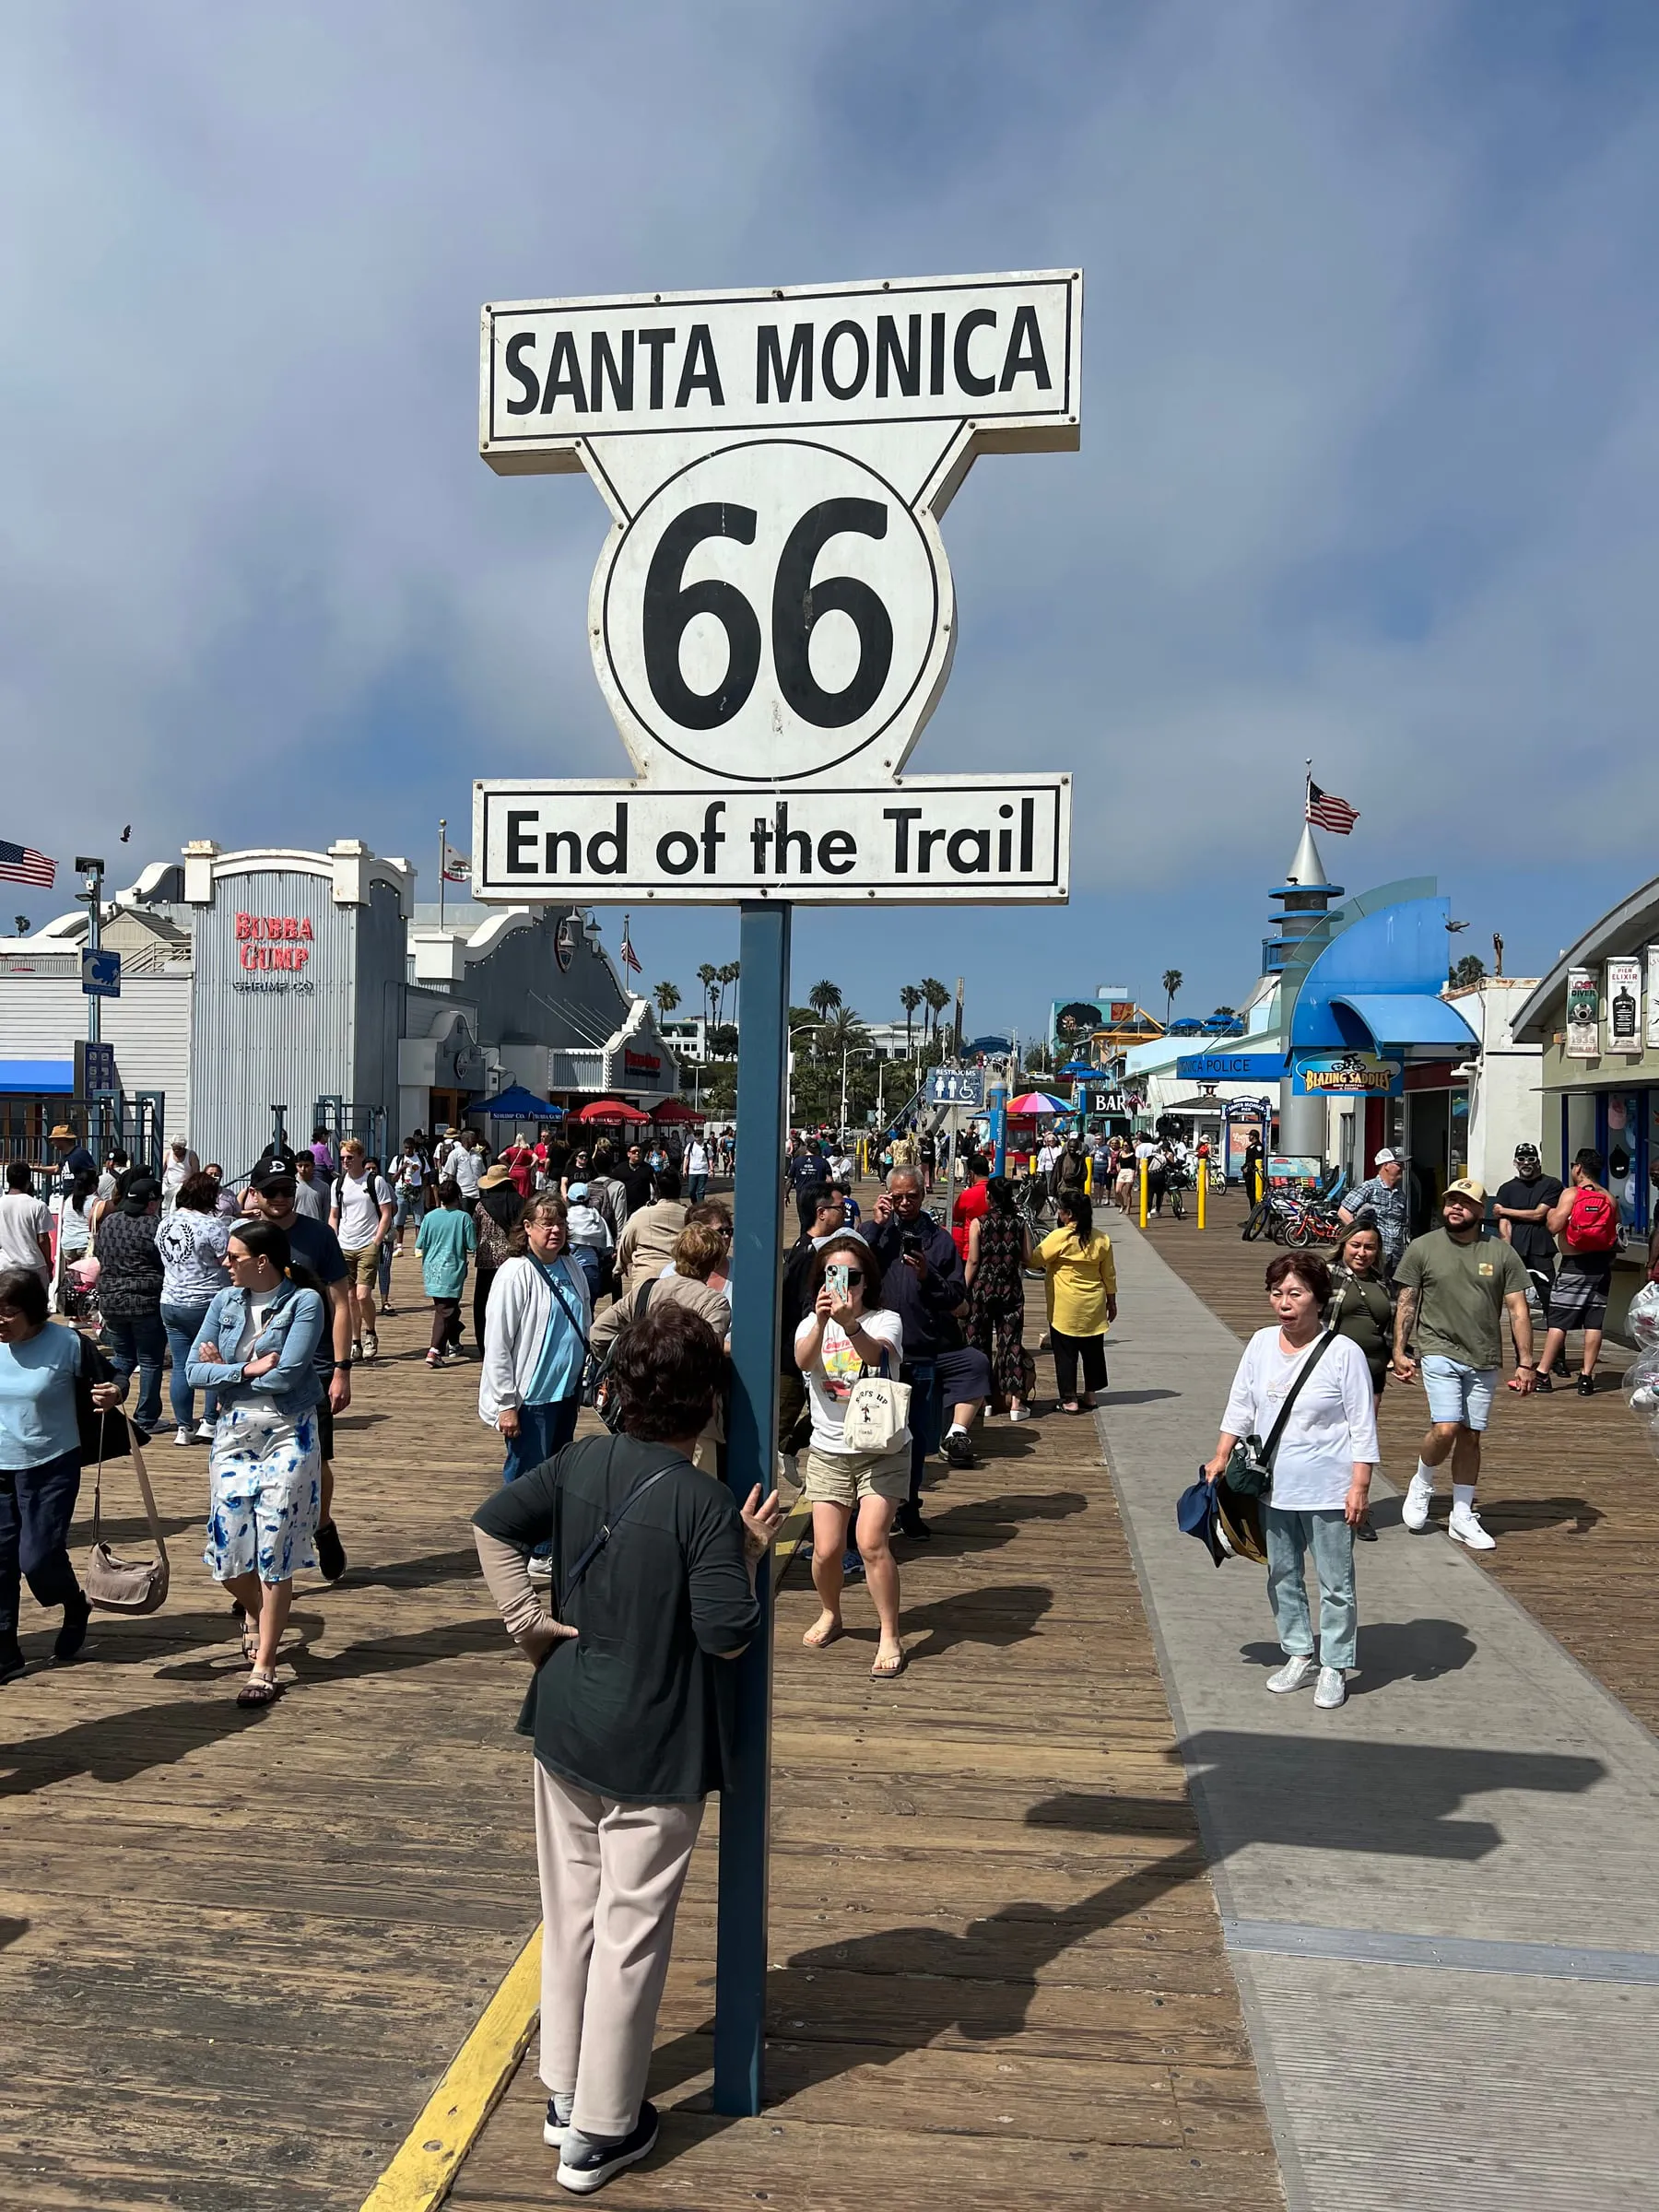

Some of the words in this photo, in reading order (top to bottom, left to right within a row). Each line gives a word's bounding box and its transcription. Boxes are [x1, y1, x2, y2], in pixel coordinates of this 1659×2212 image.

[505, 324, 724, 415] SANTA
[756, 305, 1053, 404] MONICA
[642, 498, 894, 730] 66
[506, 802, 628, 876] End
[655, 801, 725, 876] of
[750, 801, 857, 875] the
[883, 797, 1034, 873] Trail
[235, 912, 314, 940] BUBBA
[241, 943, 309, 971] GUMP
[233, 981, 288, 993] SHRIMP
[1571, 981, 1597, 989] LOST
[1206, 1059, 1252, 1072] POLICE
[1306, 1070, 1347, 1091] BLAZING
[1348, 1069, 1391, 1091] SADDLES
[1095, 1094, 1125, 1111] BAR
[996, 1110, 1005, 1148] Emergency
